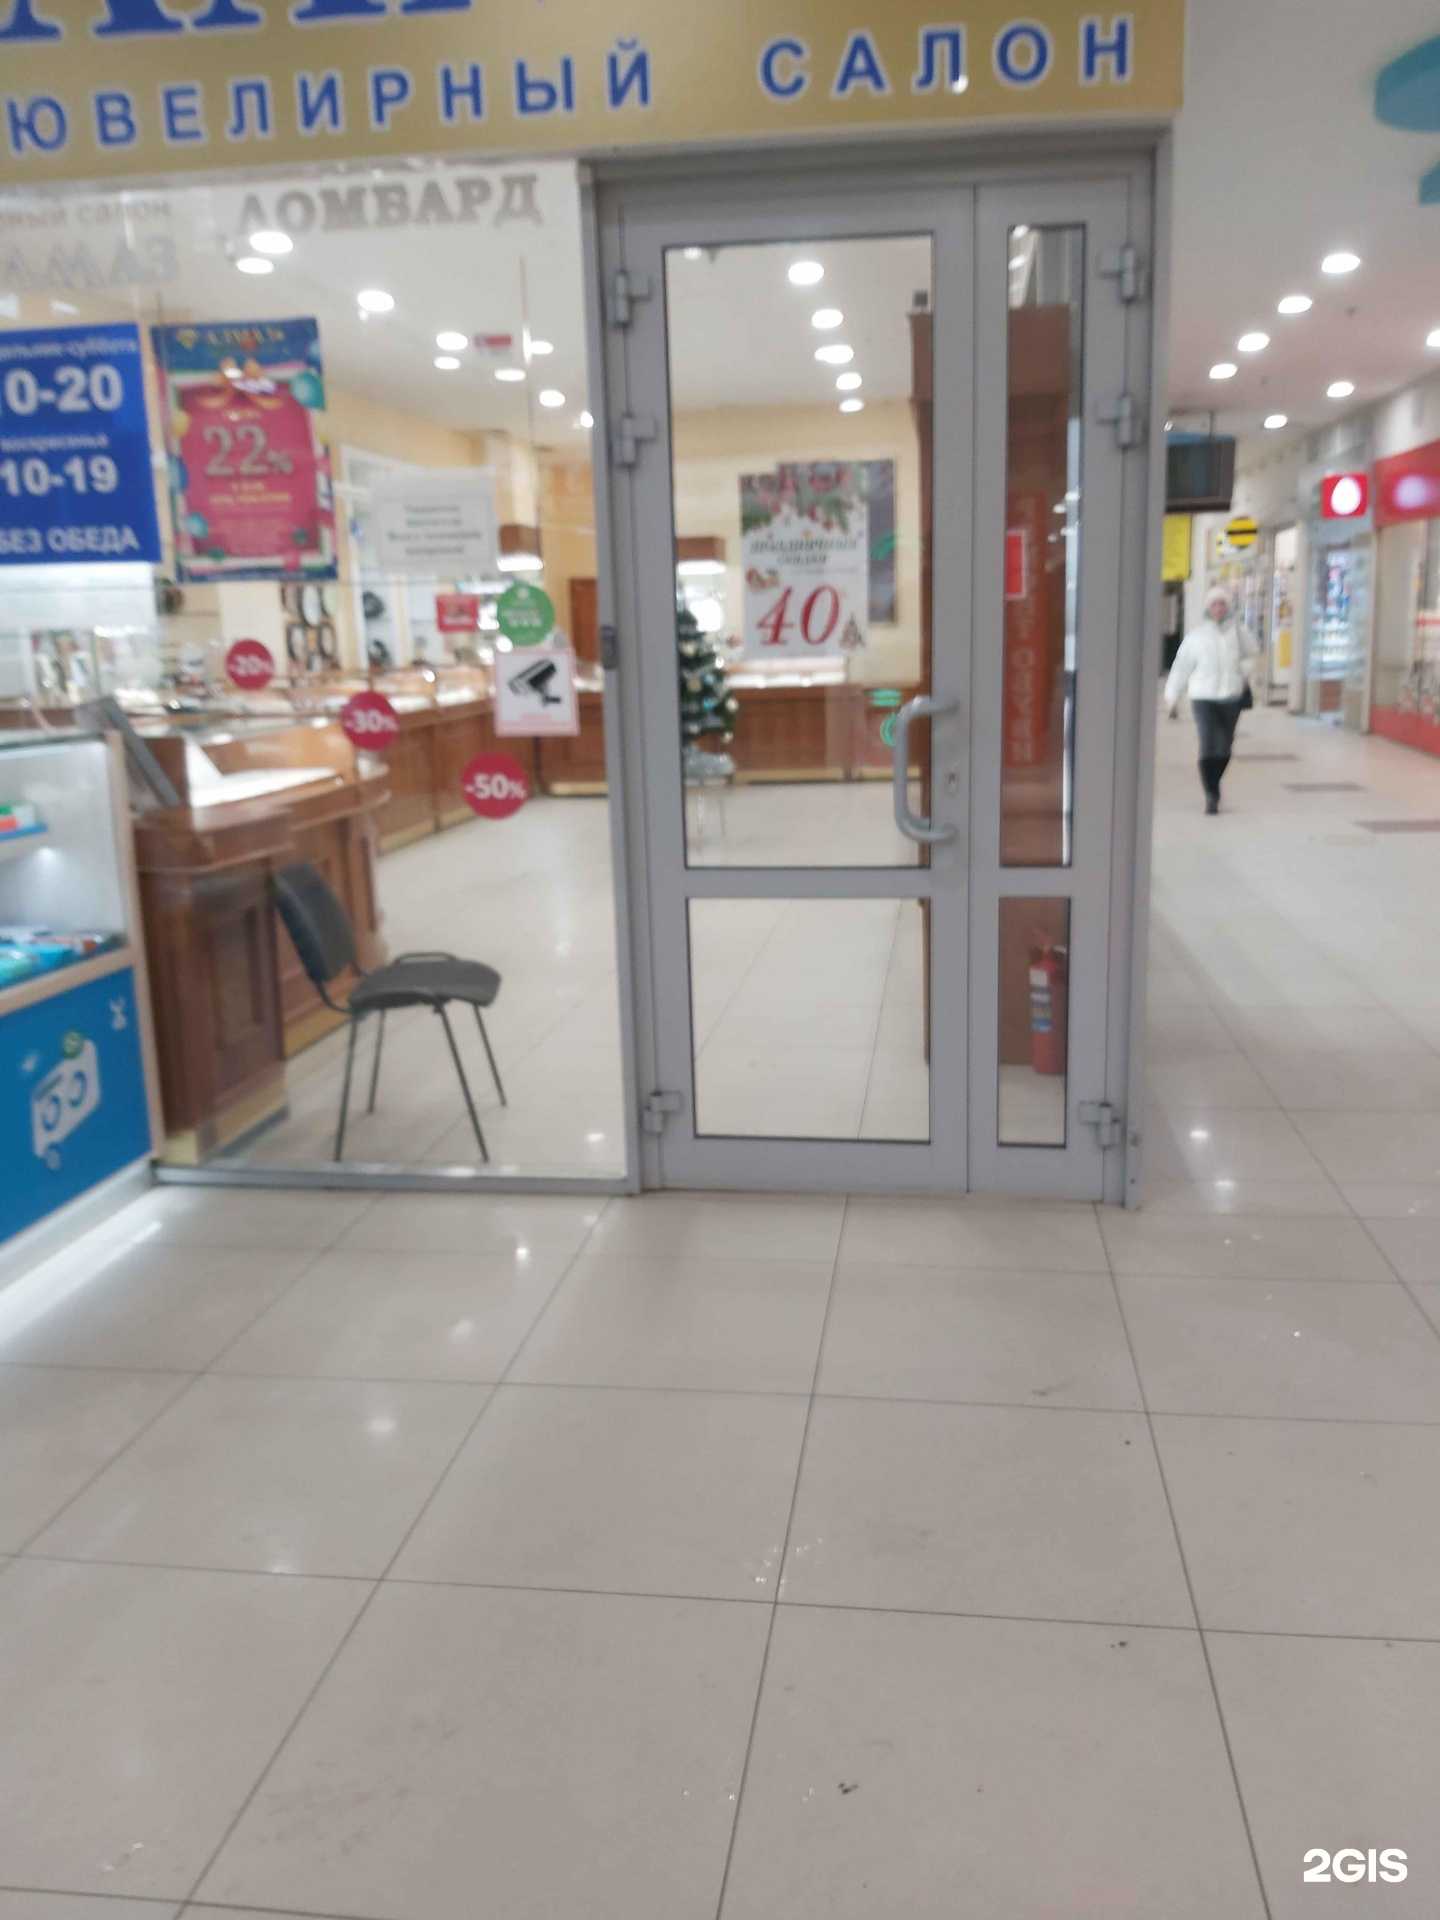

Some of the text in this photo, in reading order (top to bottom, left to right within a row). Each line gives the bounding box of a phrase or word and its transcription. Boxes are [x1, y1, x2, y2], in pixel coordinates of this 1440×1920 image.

[8, 19, 1130, 153] ЮВЕЛИРНЫЙ САЛОН
[238, 174, 543, 233] ЛОМБАРД
[0, 364, 123, 415] 0-20
[0, 456, 118, 496] 10-19
[47, 525, 140, 555] ОБЕДА
[756, 584, 840, 646] 40
[464, 772, 527, 801] -50%
